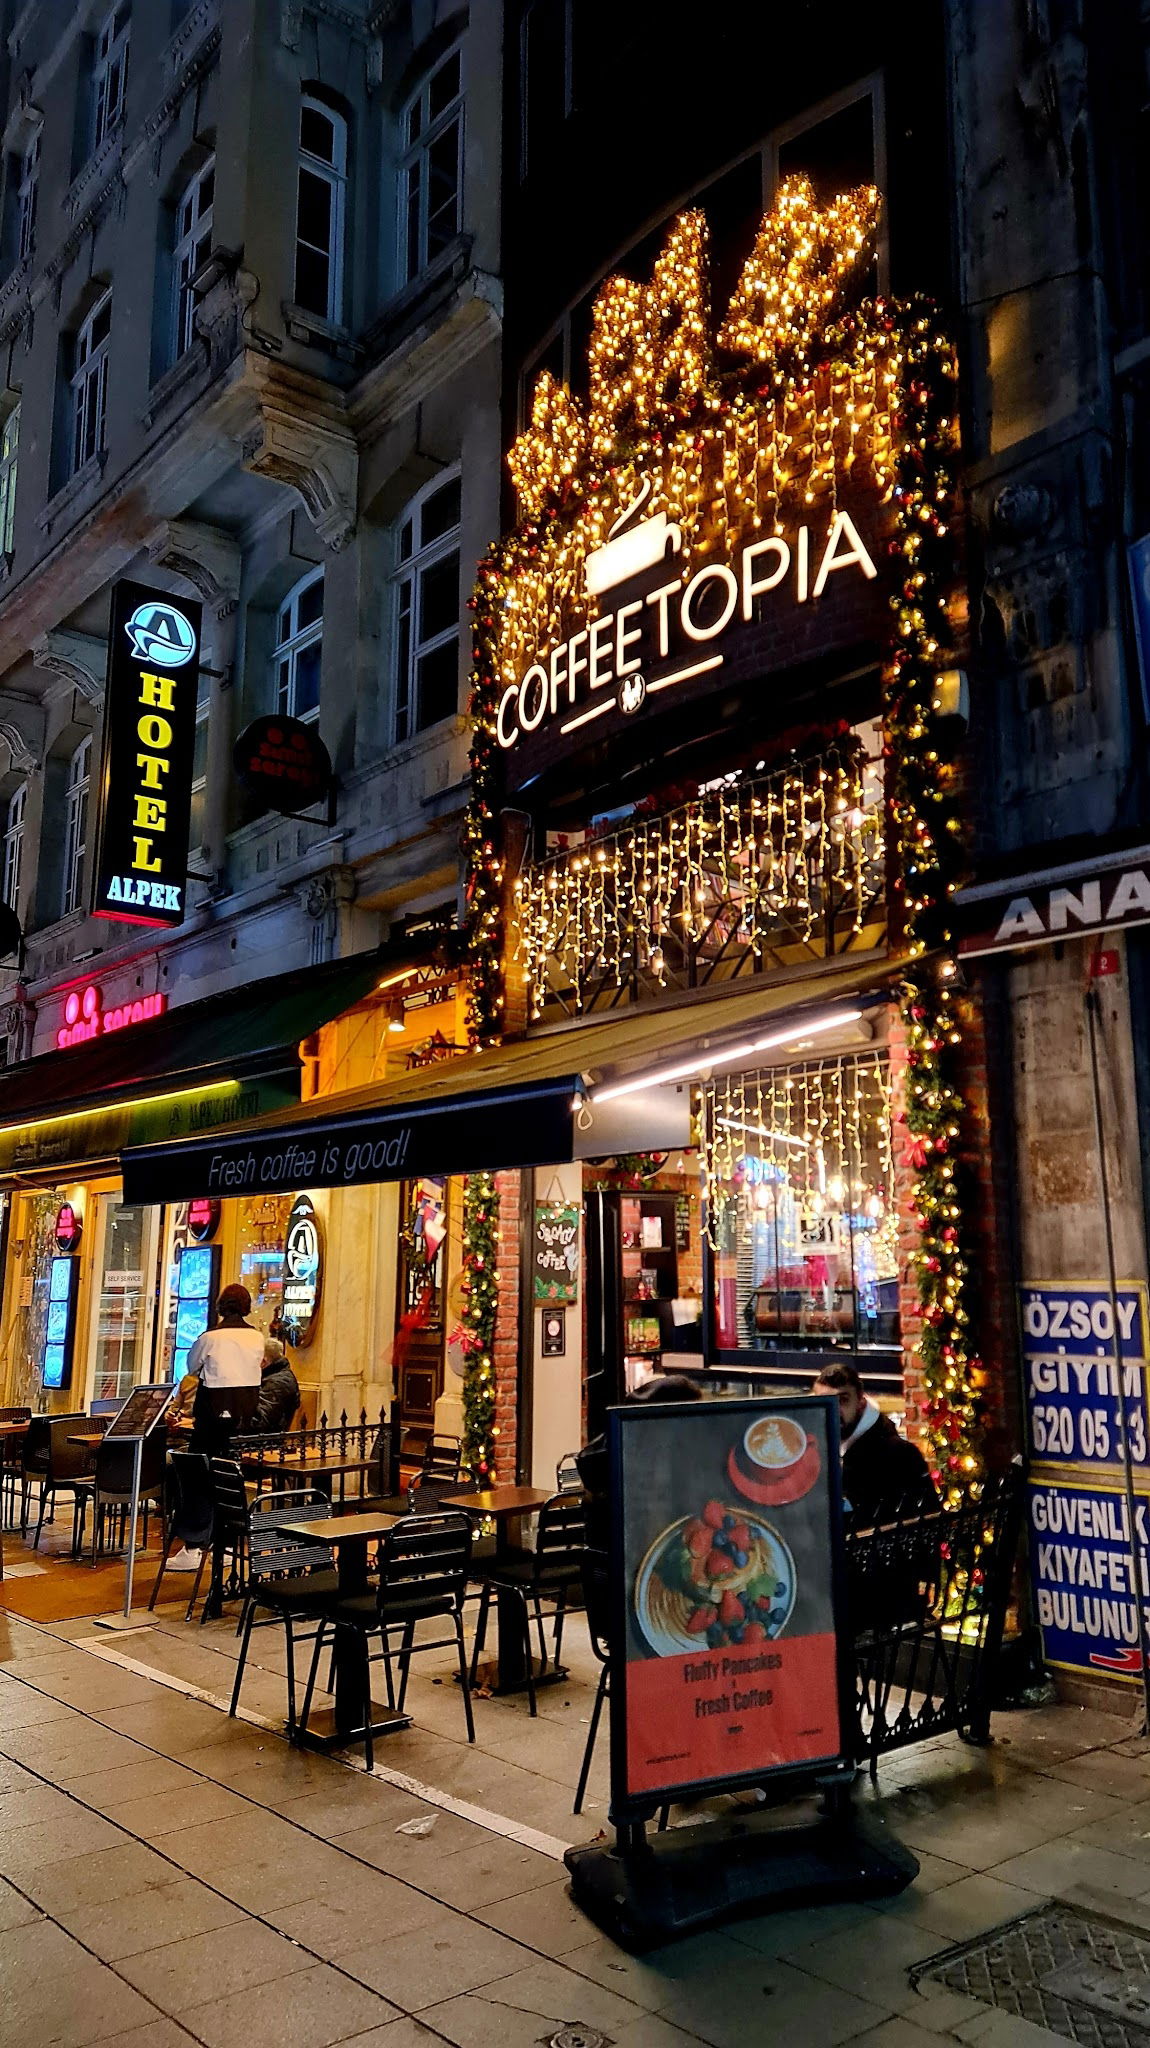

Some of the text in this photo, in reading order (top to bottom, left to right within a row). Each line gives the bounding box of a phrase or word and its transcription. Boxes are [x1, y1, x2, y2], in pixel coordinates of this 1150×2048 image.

[496, 510, 878, 748] COFFEETOPIA
[132, 671, 176, 873] HOTEL
[107, 876, 182, 911] ALPEK
[208, 1128, 411, 1187] Fresh coffee is good!
[1029, 1293, 1137, 1341] ÖZSOY
[1079, 1408, 1110, 1459] 05
[1031, 1488, 1149, 1545] GÜVENLİK
[684, 1652, 783, 1684] Fluffy Pancakes
[695, 1688, 773, 1718] Fresh Coffee
